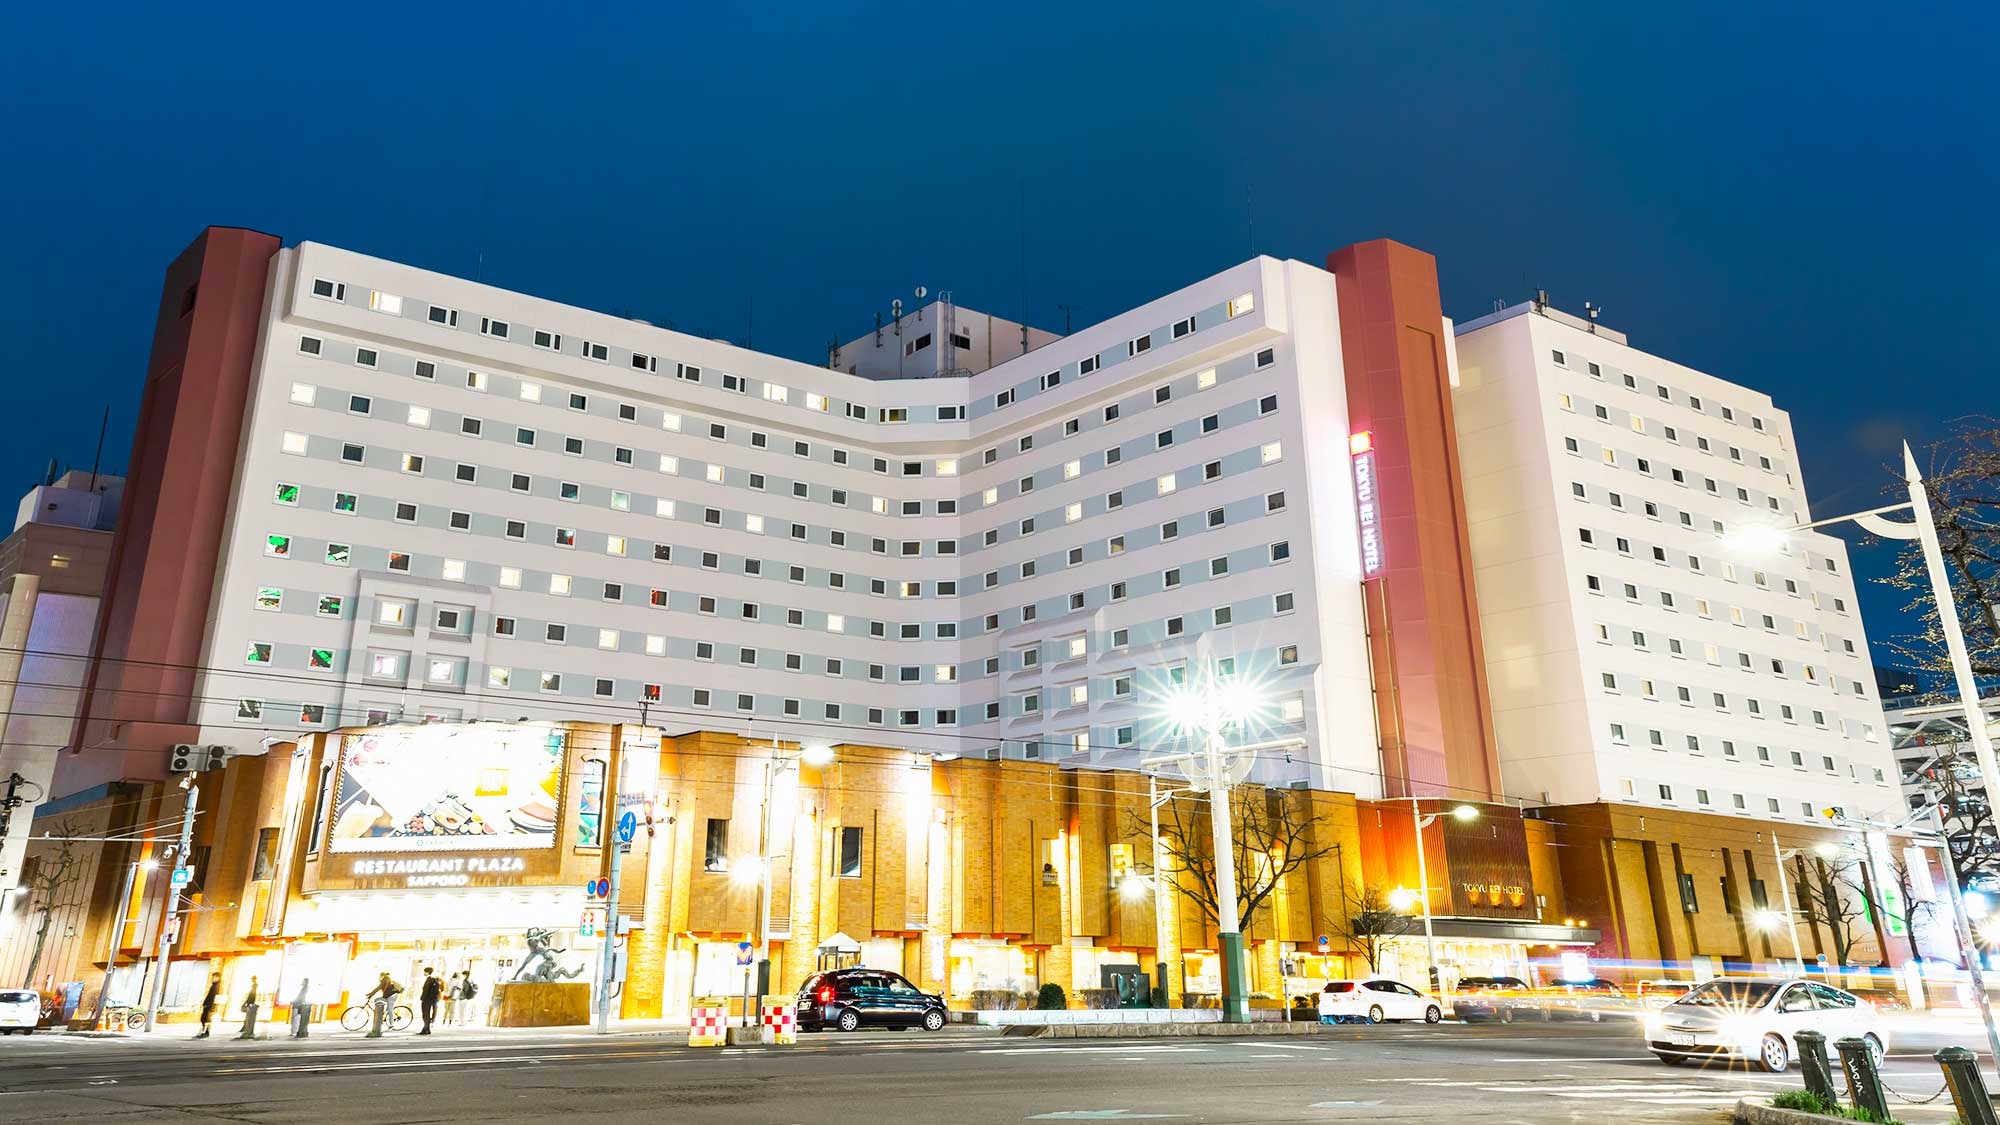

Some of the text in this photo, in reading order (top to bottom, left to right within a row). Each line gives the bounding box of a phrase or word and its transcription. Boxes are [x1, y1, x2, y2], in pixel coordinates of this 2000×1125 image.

[1356, 456, 1379, 573] TOKYU REI HOTEL
[354, 857, 524, 874] RESTAURANT PLAZA
[407, 875, 469, 886] SAPPORO
[1463, 883, 1487, 893] TOKYU
[1503, 886, 1525, 895] HOTEL
